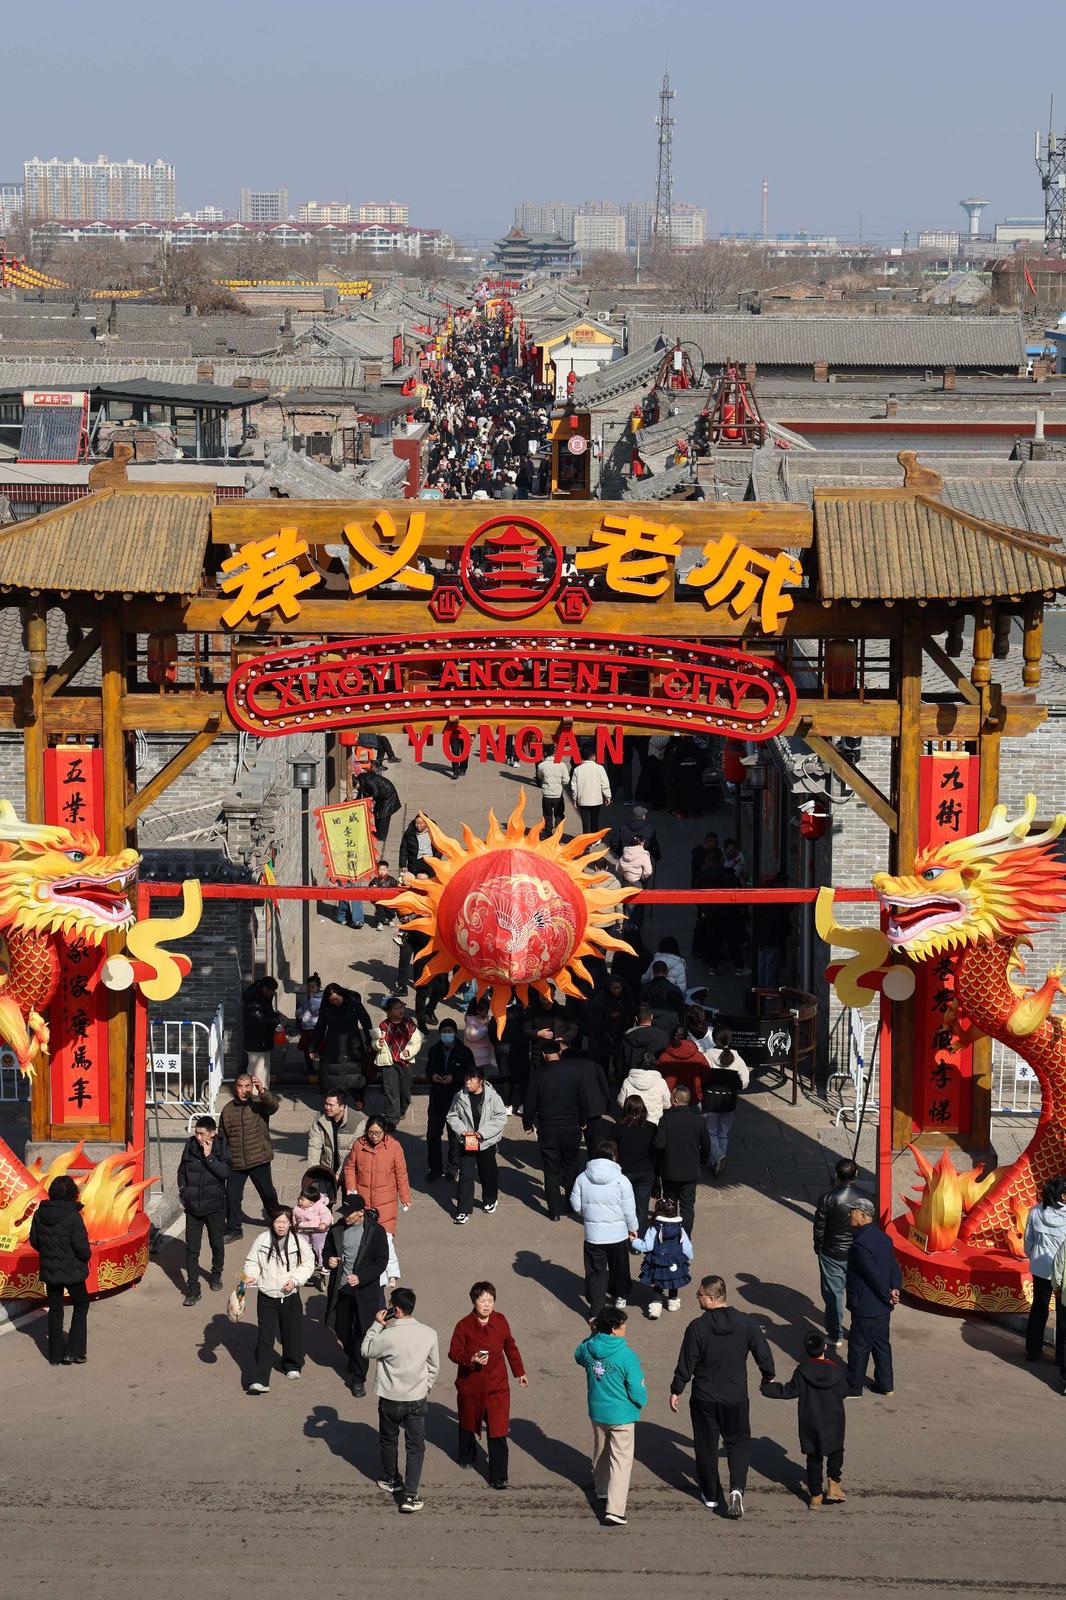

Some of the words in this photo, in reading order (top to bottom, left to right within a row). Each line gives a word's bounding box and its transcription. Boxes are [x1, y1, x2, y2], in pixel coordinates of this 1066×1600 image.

[221, 510, 434, 627] 孝义
[575, 515, 804, 633] 老城
[565, 592, 583, 614] 西
[273, 663, 403, 708] XIAOYI
[439, 660, 627, 693] ANCIENT
[663, 672, 751, 709] CITY
[404, 723, 624, 765] YONGAN
[155, 1059, 177, 1069] 公安
